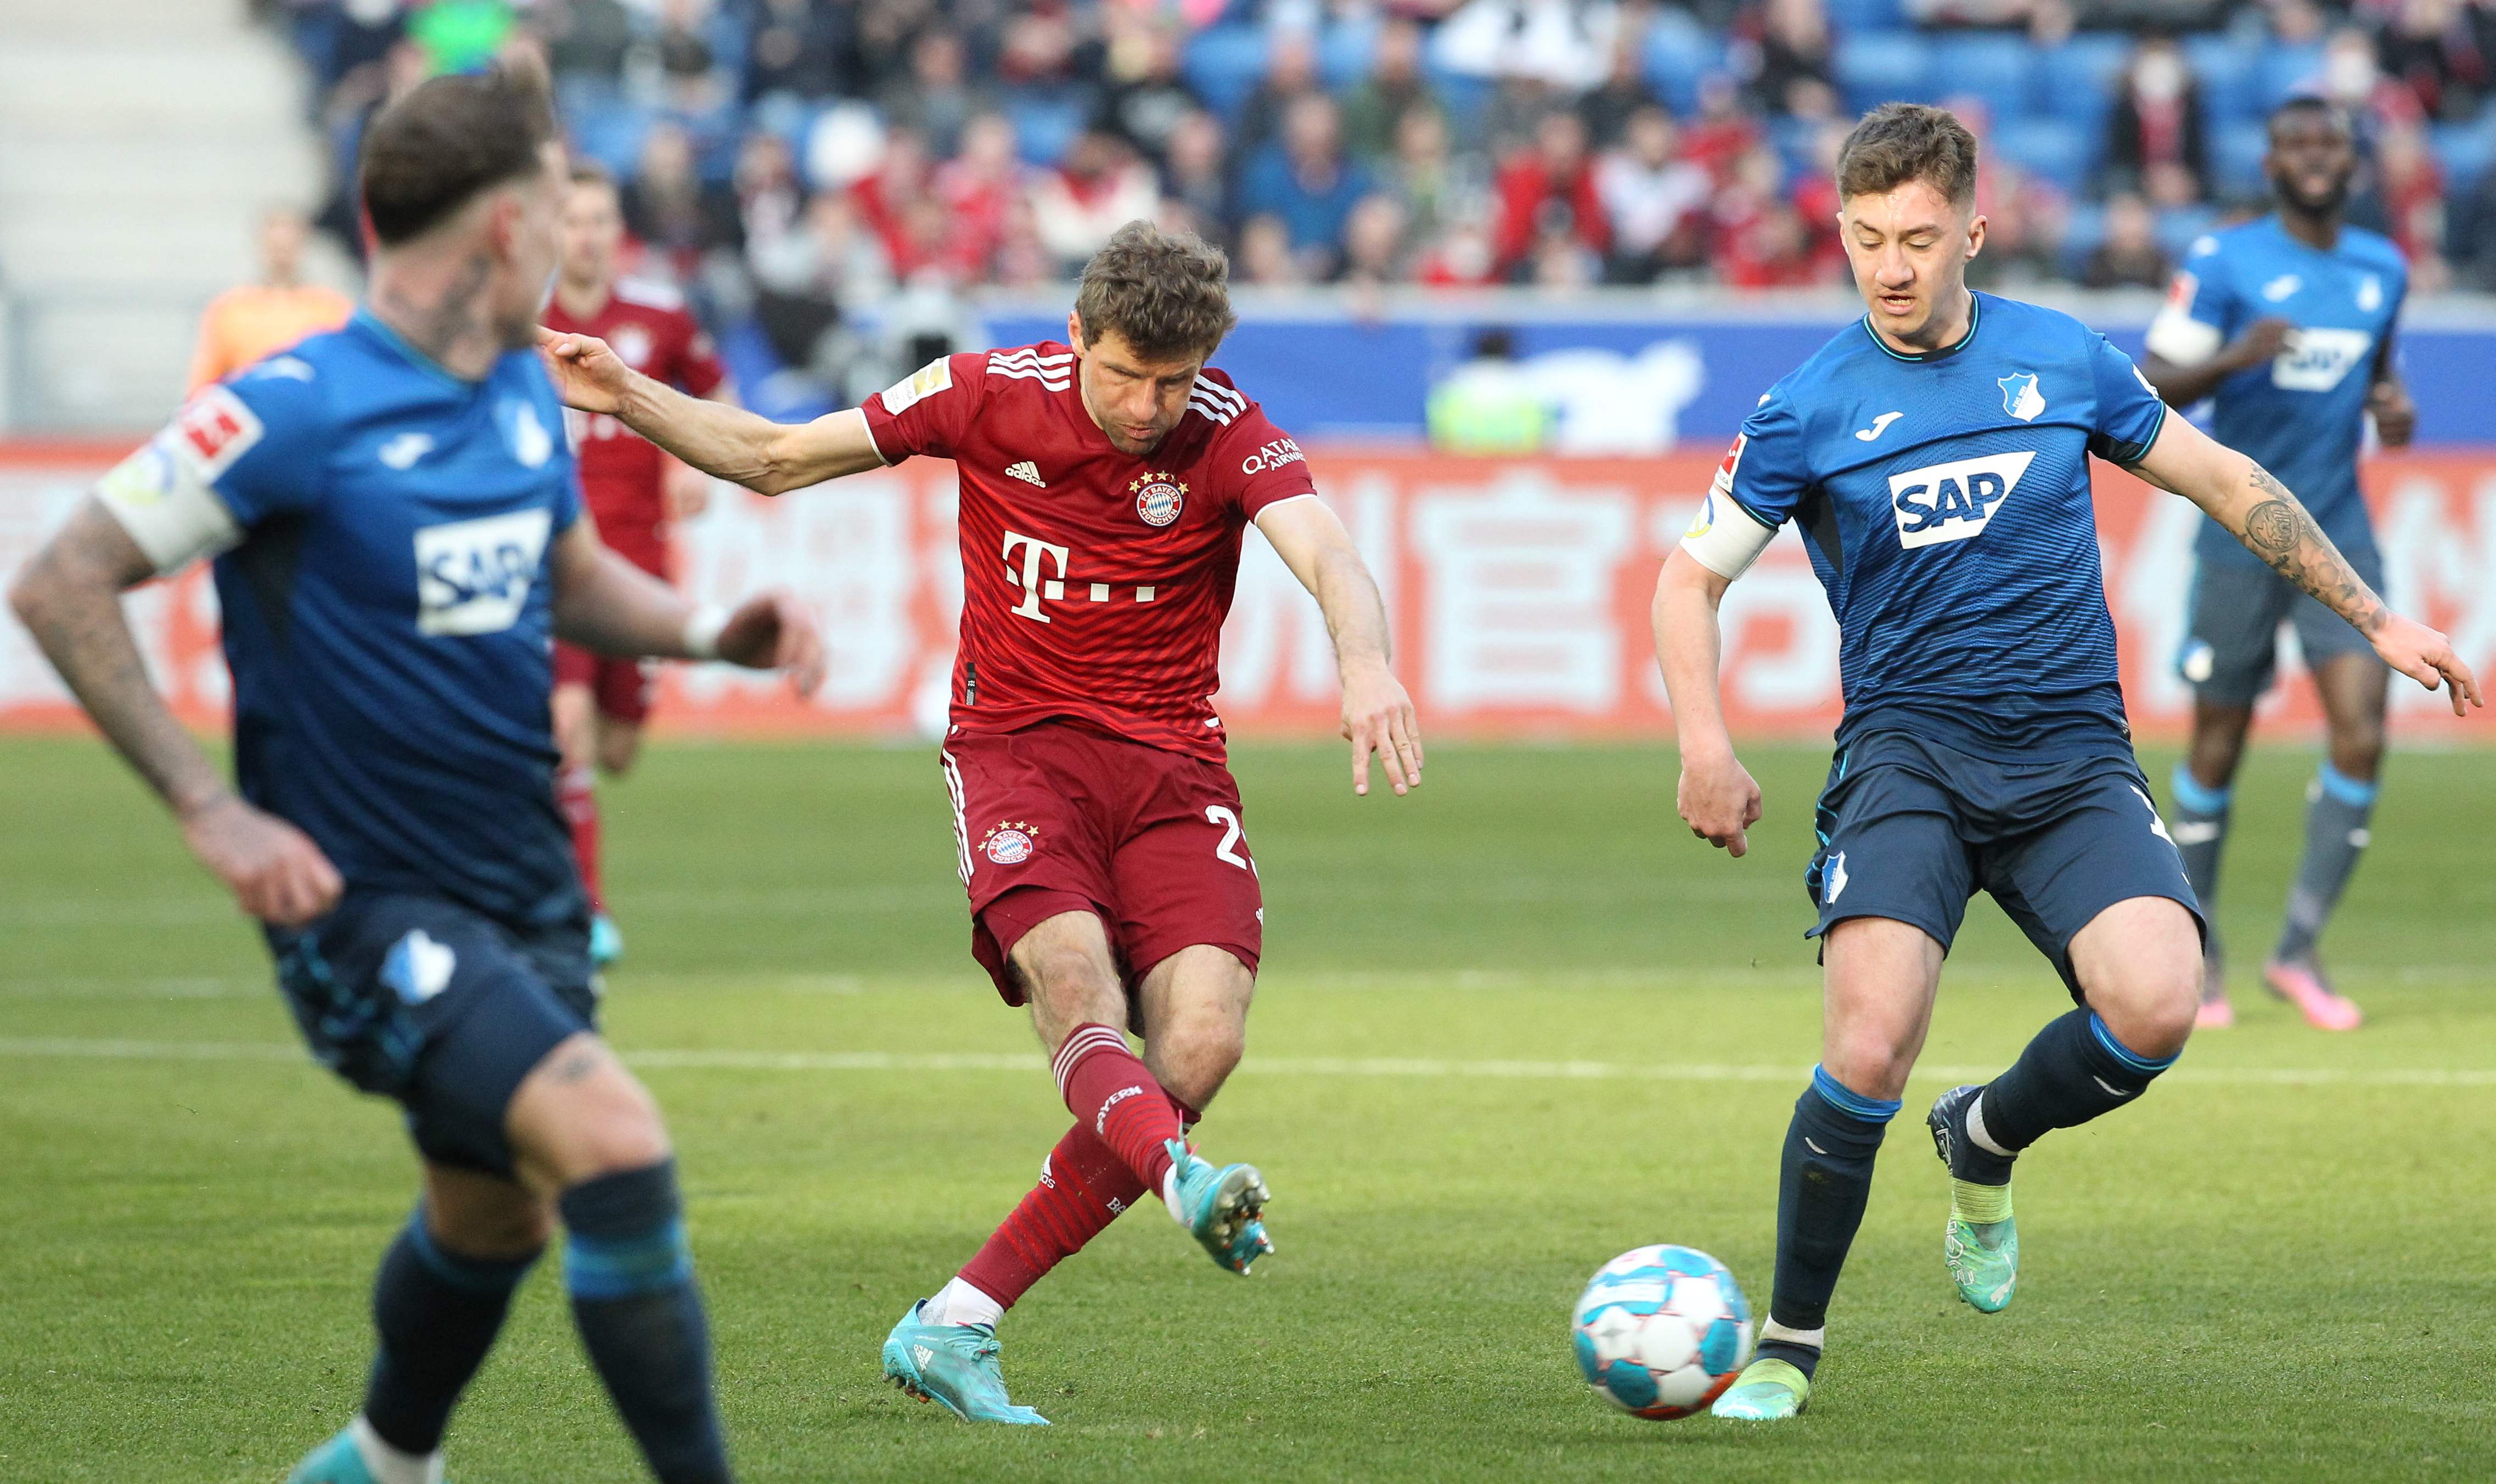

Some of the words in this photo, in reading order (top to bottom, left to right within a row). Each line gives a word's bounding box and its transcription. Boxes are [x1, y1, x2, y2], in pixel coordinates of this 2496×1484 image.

[1005, 466, 1046, 488] adidas
[1141, 491, 1151, 502] FC
[1150, 486, 1179, 502] BAYERN
[1896, 472, 2005, 533] SAP
[997, 833, 1028, 844] BAYERN
[1205, 805, 1258, 878] 2
